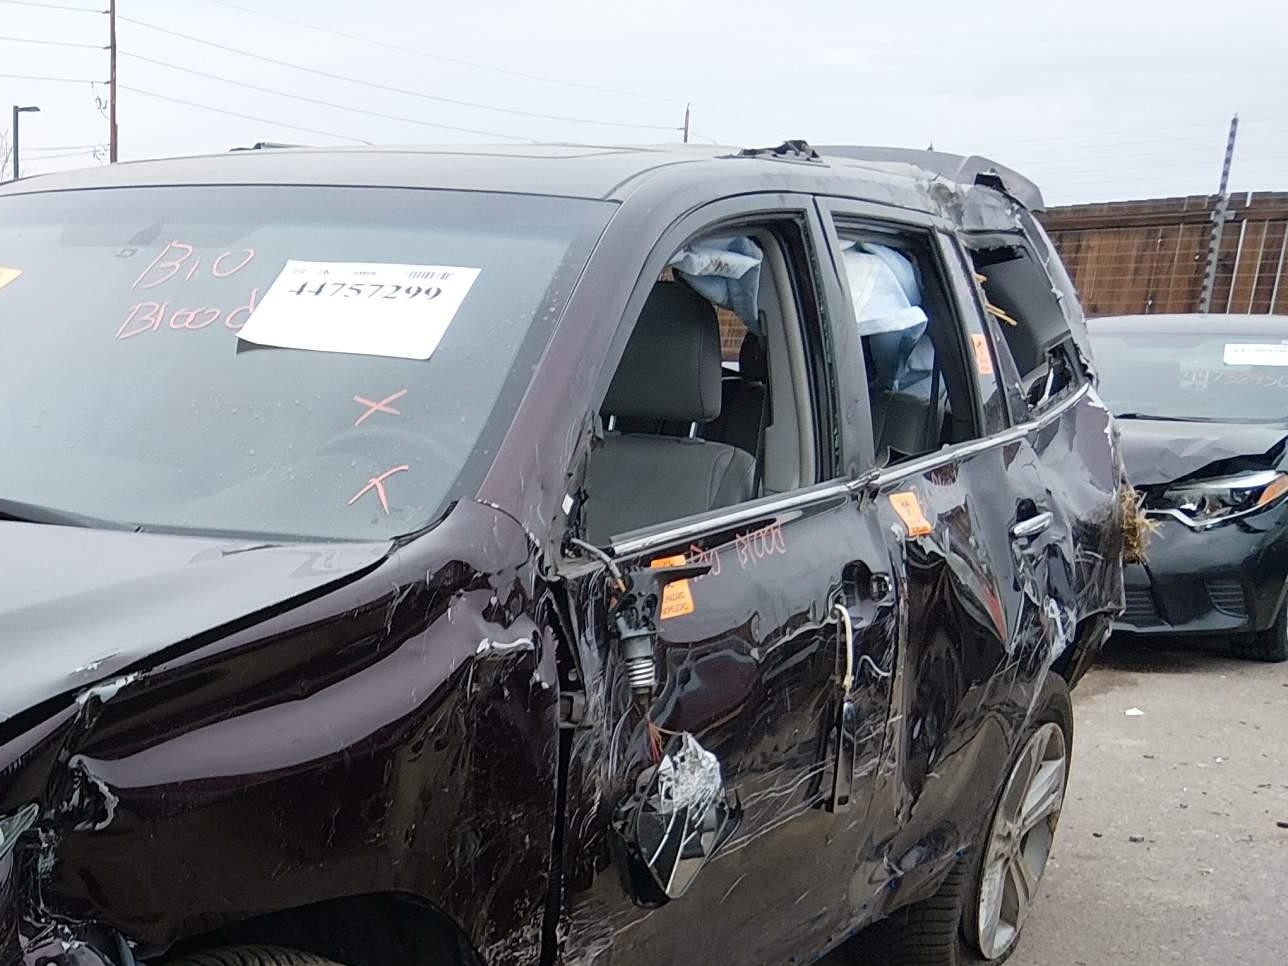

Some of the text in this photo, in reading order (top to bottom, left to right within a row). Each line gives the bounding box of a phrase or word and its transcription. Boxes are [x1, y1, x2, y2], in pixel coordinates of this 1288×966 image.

[115, 287, 259, 340] Blood
[288, 282, 443, 300] 44757299
[735, 515, 787, 570] Blood
